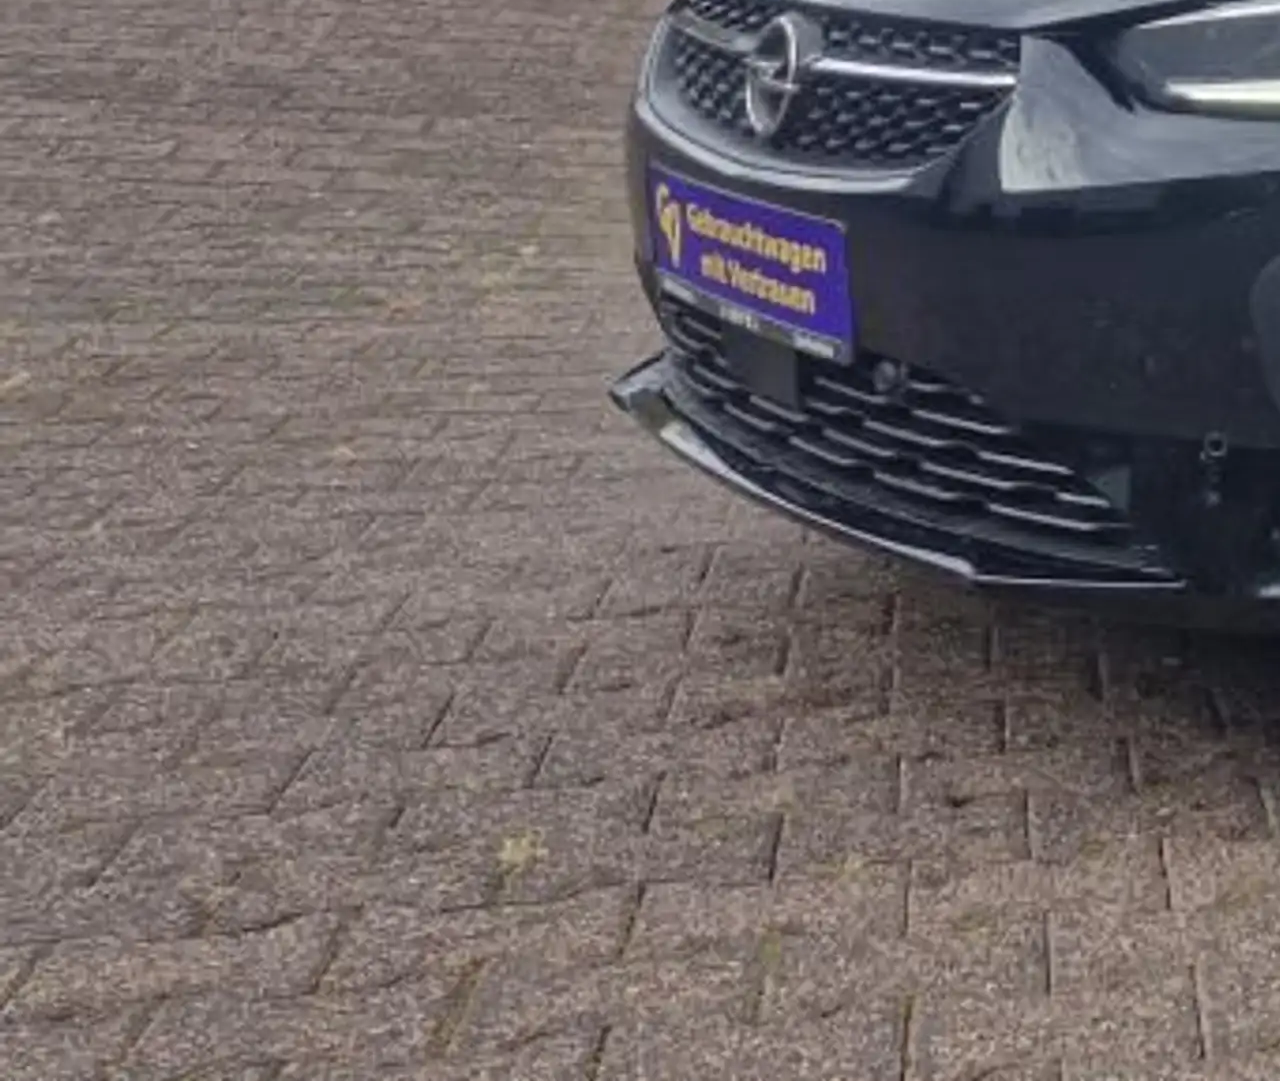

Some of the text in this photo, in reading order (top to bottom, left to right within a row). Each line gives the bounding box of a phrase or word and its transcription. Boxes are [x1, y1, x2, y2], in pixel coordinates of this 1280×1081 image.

[686, 202, 827, 275] Gebrauchtwagen
[700, 250, 728, 285] mit
[727, 259, 817, 316] Vertrauen
